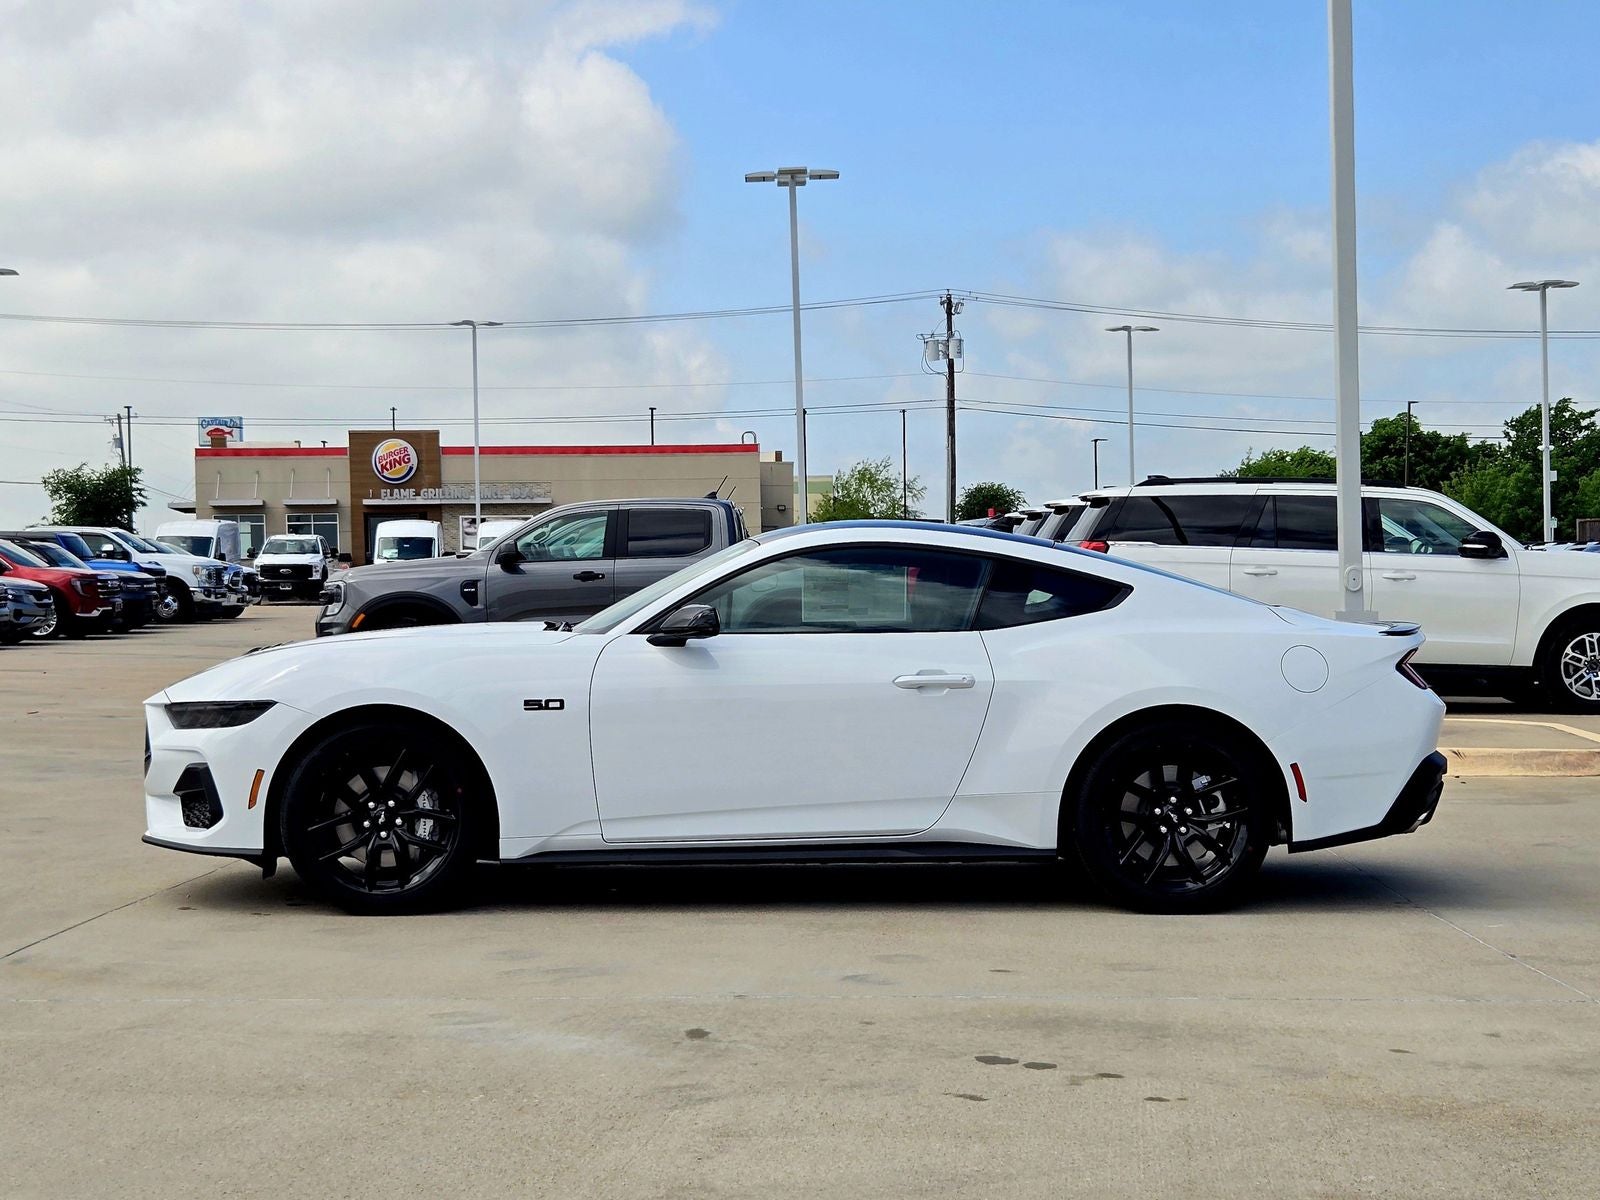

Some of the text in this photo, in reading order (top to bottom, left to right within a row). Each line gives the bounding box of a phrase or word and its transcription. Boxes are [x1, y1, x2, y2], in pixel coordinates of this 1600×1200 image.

[378, 446, 409, 464] BURGER
[380, 453, 411, 474] KING
[380, 488, 416, 500] FLAME
